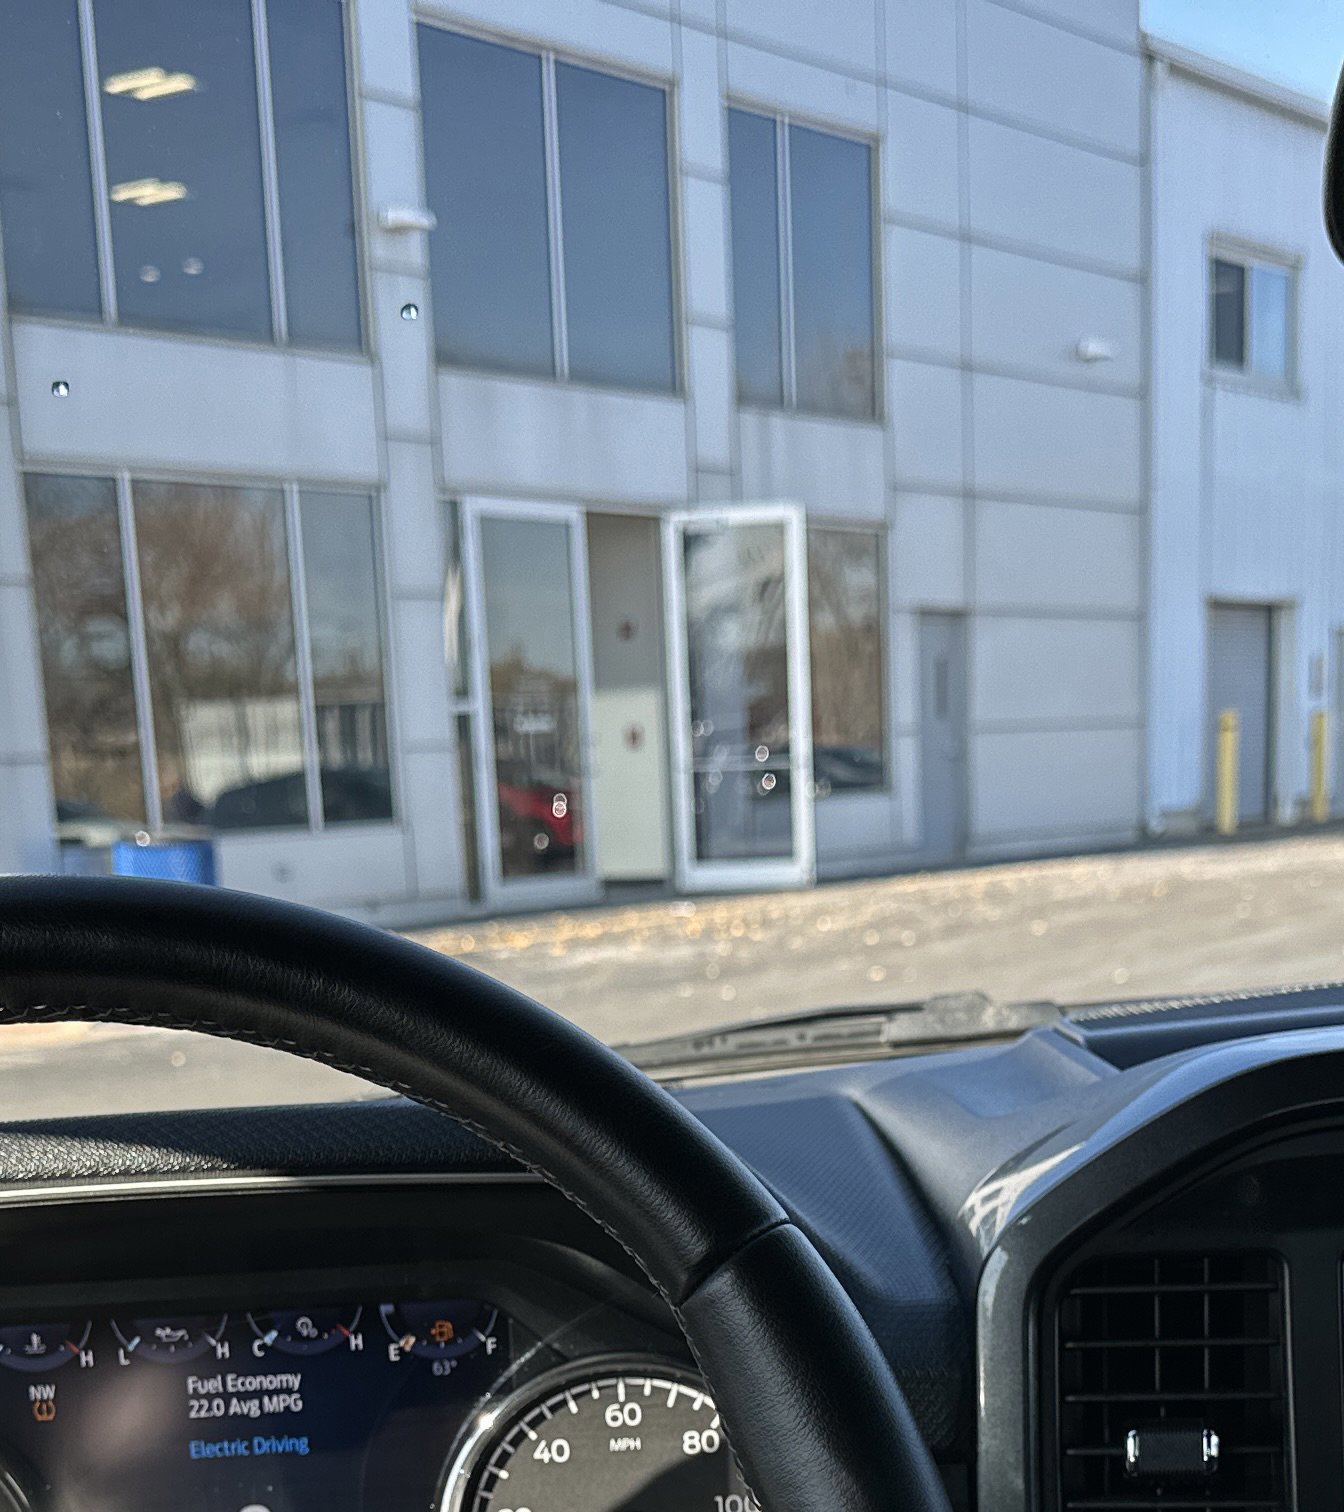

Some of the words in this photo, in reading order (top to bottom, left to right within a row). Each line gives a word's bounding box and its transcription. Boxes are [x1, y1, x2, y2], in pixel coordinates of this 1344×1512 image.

[216, 1342, 230, 1360] H
[252, 1338, 266, 1358] C
[349, 1333, 364, 1352] H
[485, 1336, 498, 1355] F
[79, 1350, 94, 1368] H
[118, 1348, 131, 1366] L
[388, 1343, 401, 1362] E
[29, 1384, 56, 1401] NW
[187, 1374, 223, 1396] Fuel
[225, 1371, 302, 1397] Economy
[188, 1397, 225, 1418] 22.0
[228, 1396, 262, 1419] Avg
[263, 1393, 304, 1413] MPG
[604, 1402, 642, 1428] 60
[189, 1435, 250, 1459] Electric
[252, 1433, 310, 1459] Driving
[532, 1437, 571, 1464] 40
[609, 1436, 642, 1452] MPH
[682, 1428, 721, 1455] 80
